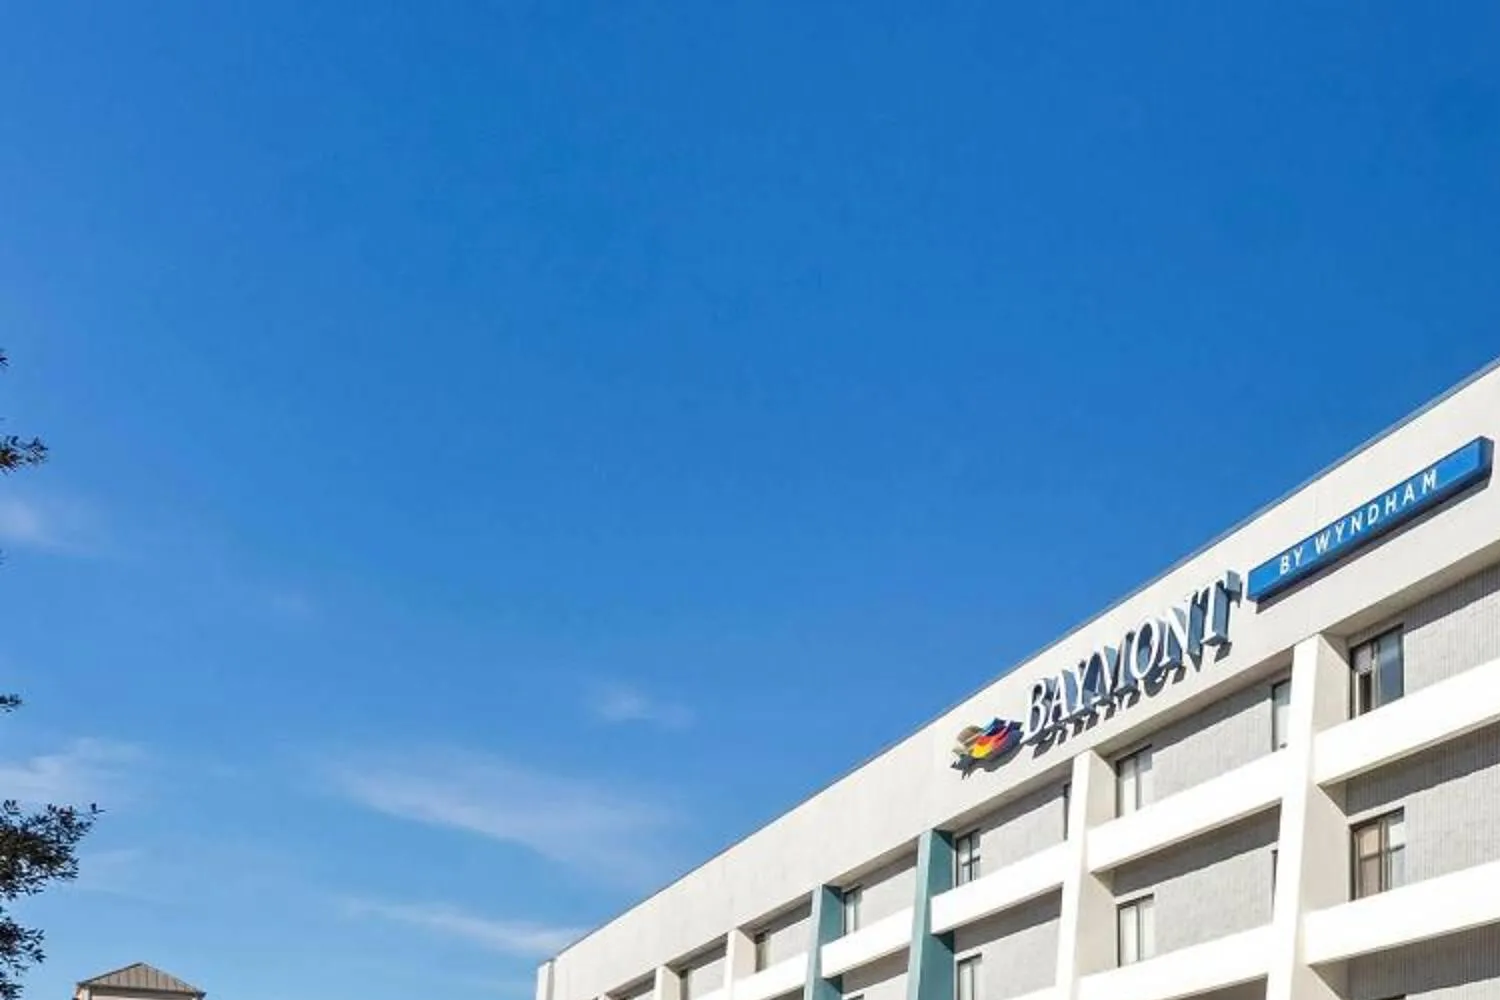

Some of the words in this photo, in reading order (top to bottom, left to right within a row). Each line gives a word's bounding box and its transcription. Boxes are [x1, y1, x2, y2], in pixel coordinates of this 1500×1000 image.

[1279, 547, 1304, 576] BY
[1314, 468, 1437, 555] WYNDHAM
[1020, 570, 1241, 745] BAYMONT
